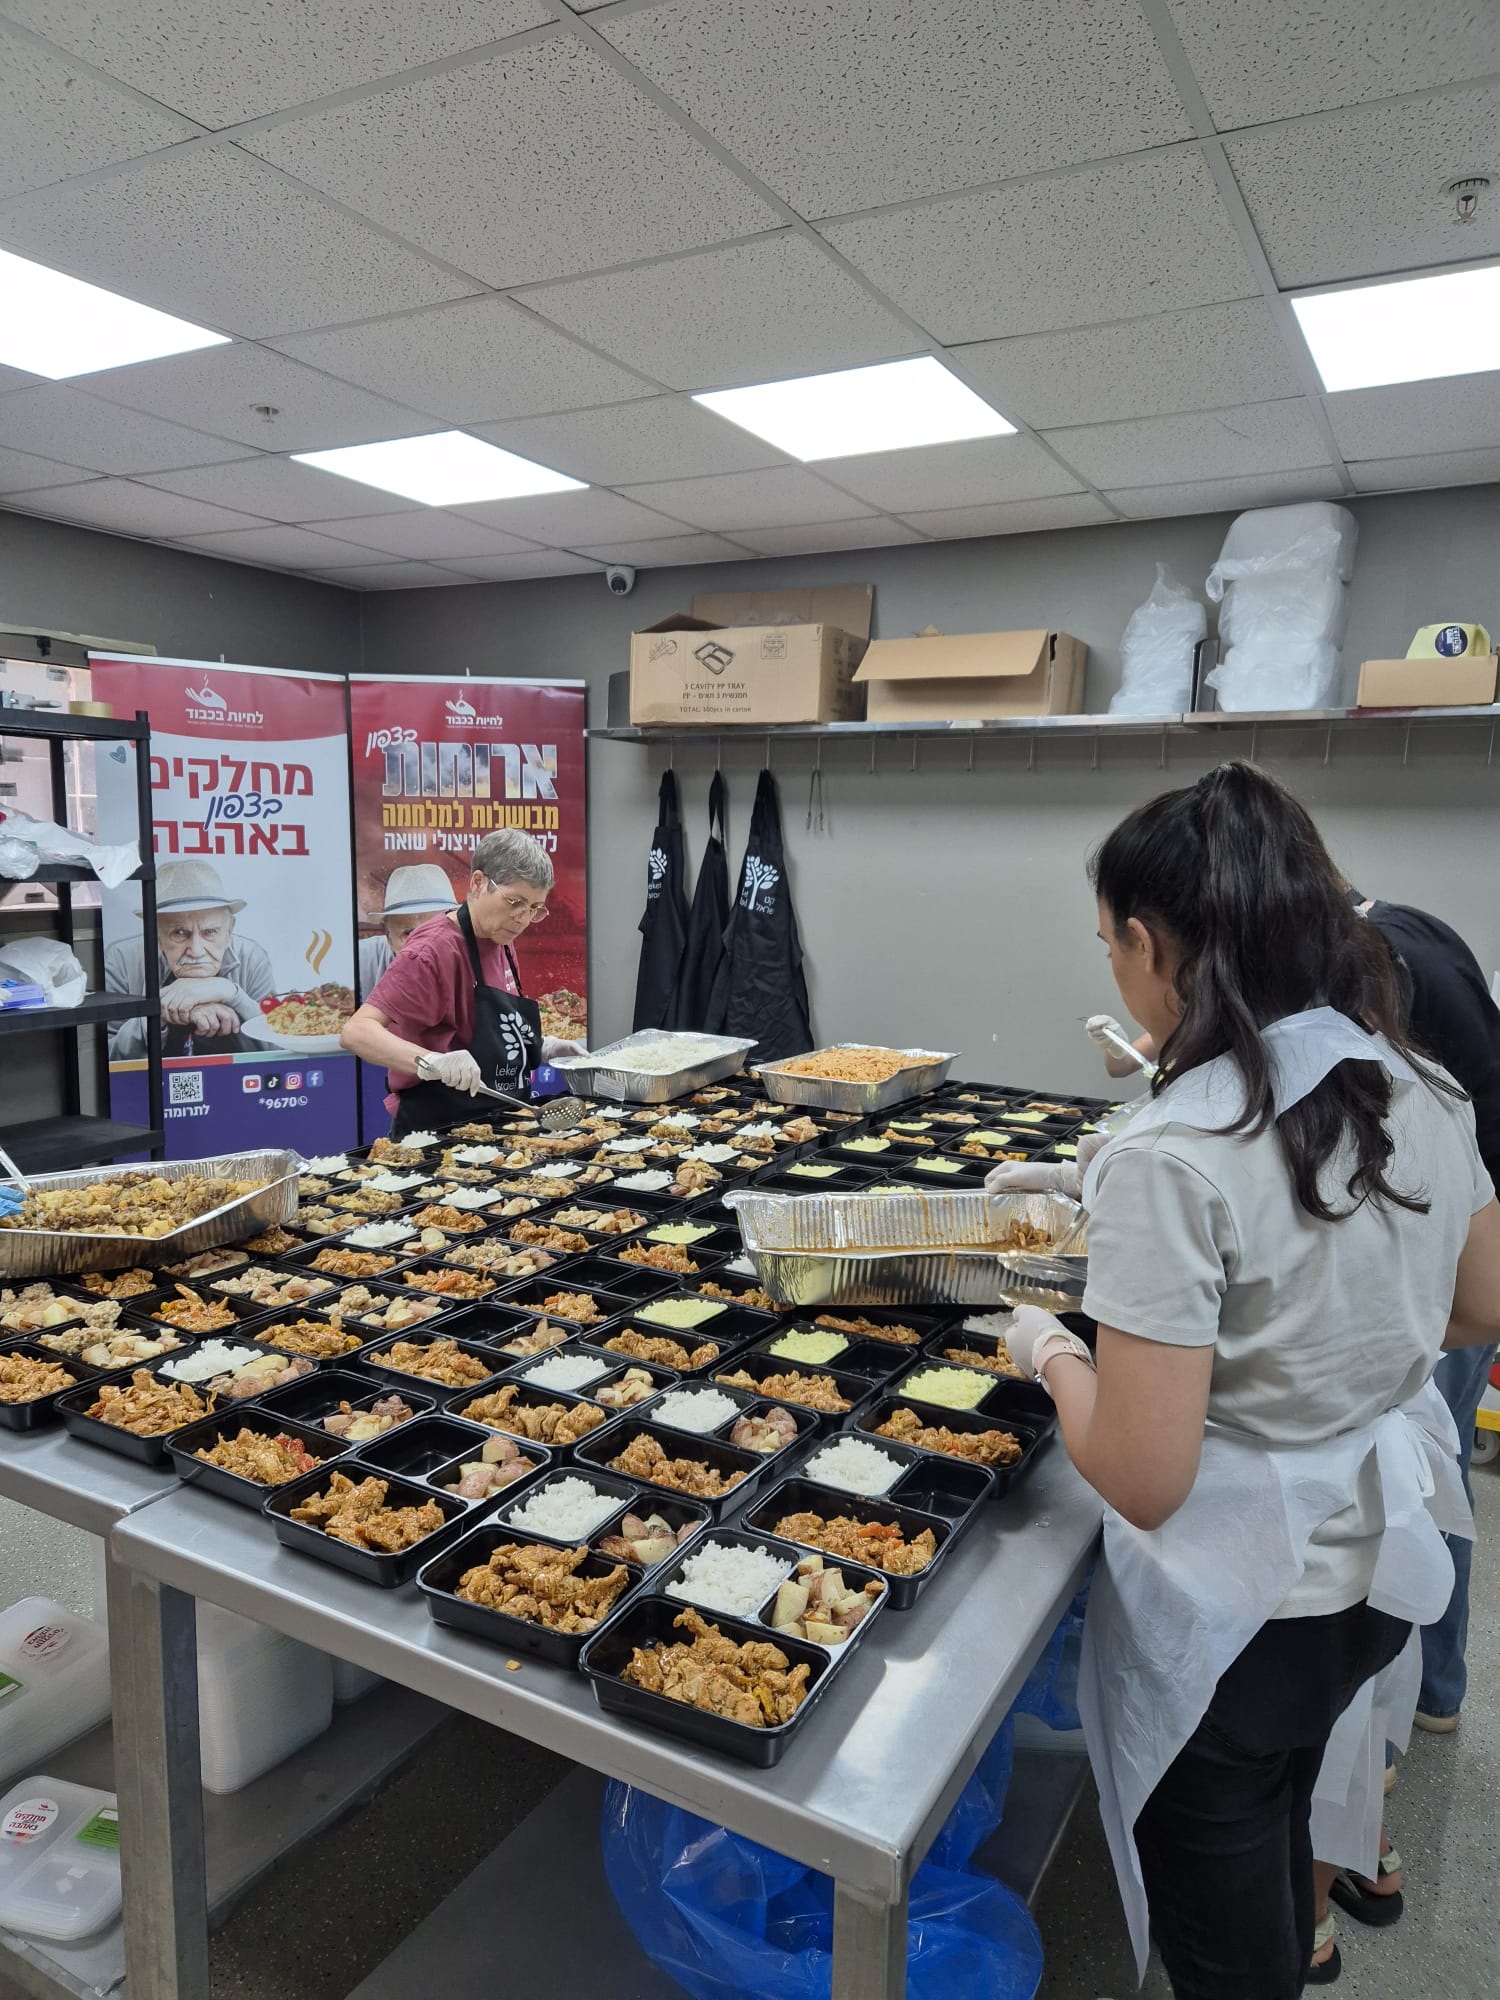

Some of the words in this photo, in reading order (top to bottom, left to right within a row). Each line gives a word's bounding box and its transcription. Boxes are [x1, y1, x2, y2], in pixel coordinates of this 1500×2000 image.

[728, 682, 746, 690] TRAY
[185, 708, 225, 721] בכבוד
[227, 711, 264, 724] לחיות
[445, 715, 474, 725] בכבוד
[476, 715, 503, 726] לחיות
[365, 726, 418, 758] בצפון
[150, 754, 314, 799] מחלקים
[382, 741, 559, 799] ארוחות
[203, 792, 283, 831] בצפון
[382, 799, 465, 828] למלחמה
[471, 800, 559, 830] מבושלות
[152, 820, 310, 856] באהבה
[384, 832, 427, 851] שואה
[495, 1063, 518, 1076] Leke
[163, 1103, 211, 1119] לתרומה
[14, 1811, 47, 1822] מחלקים
